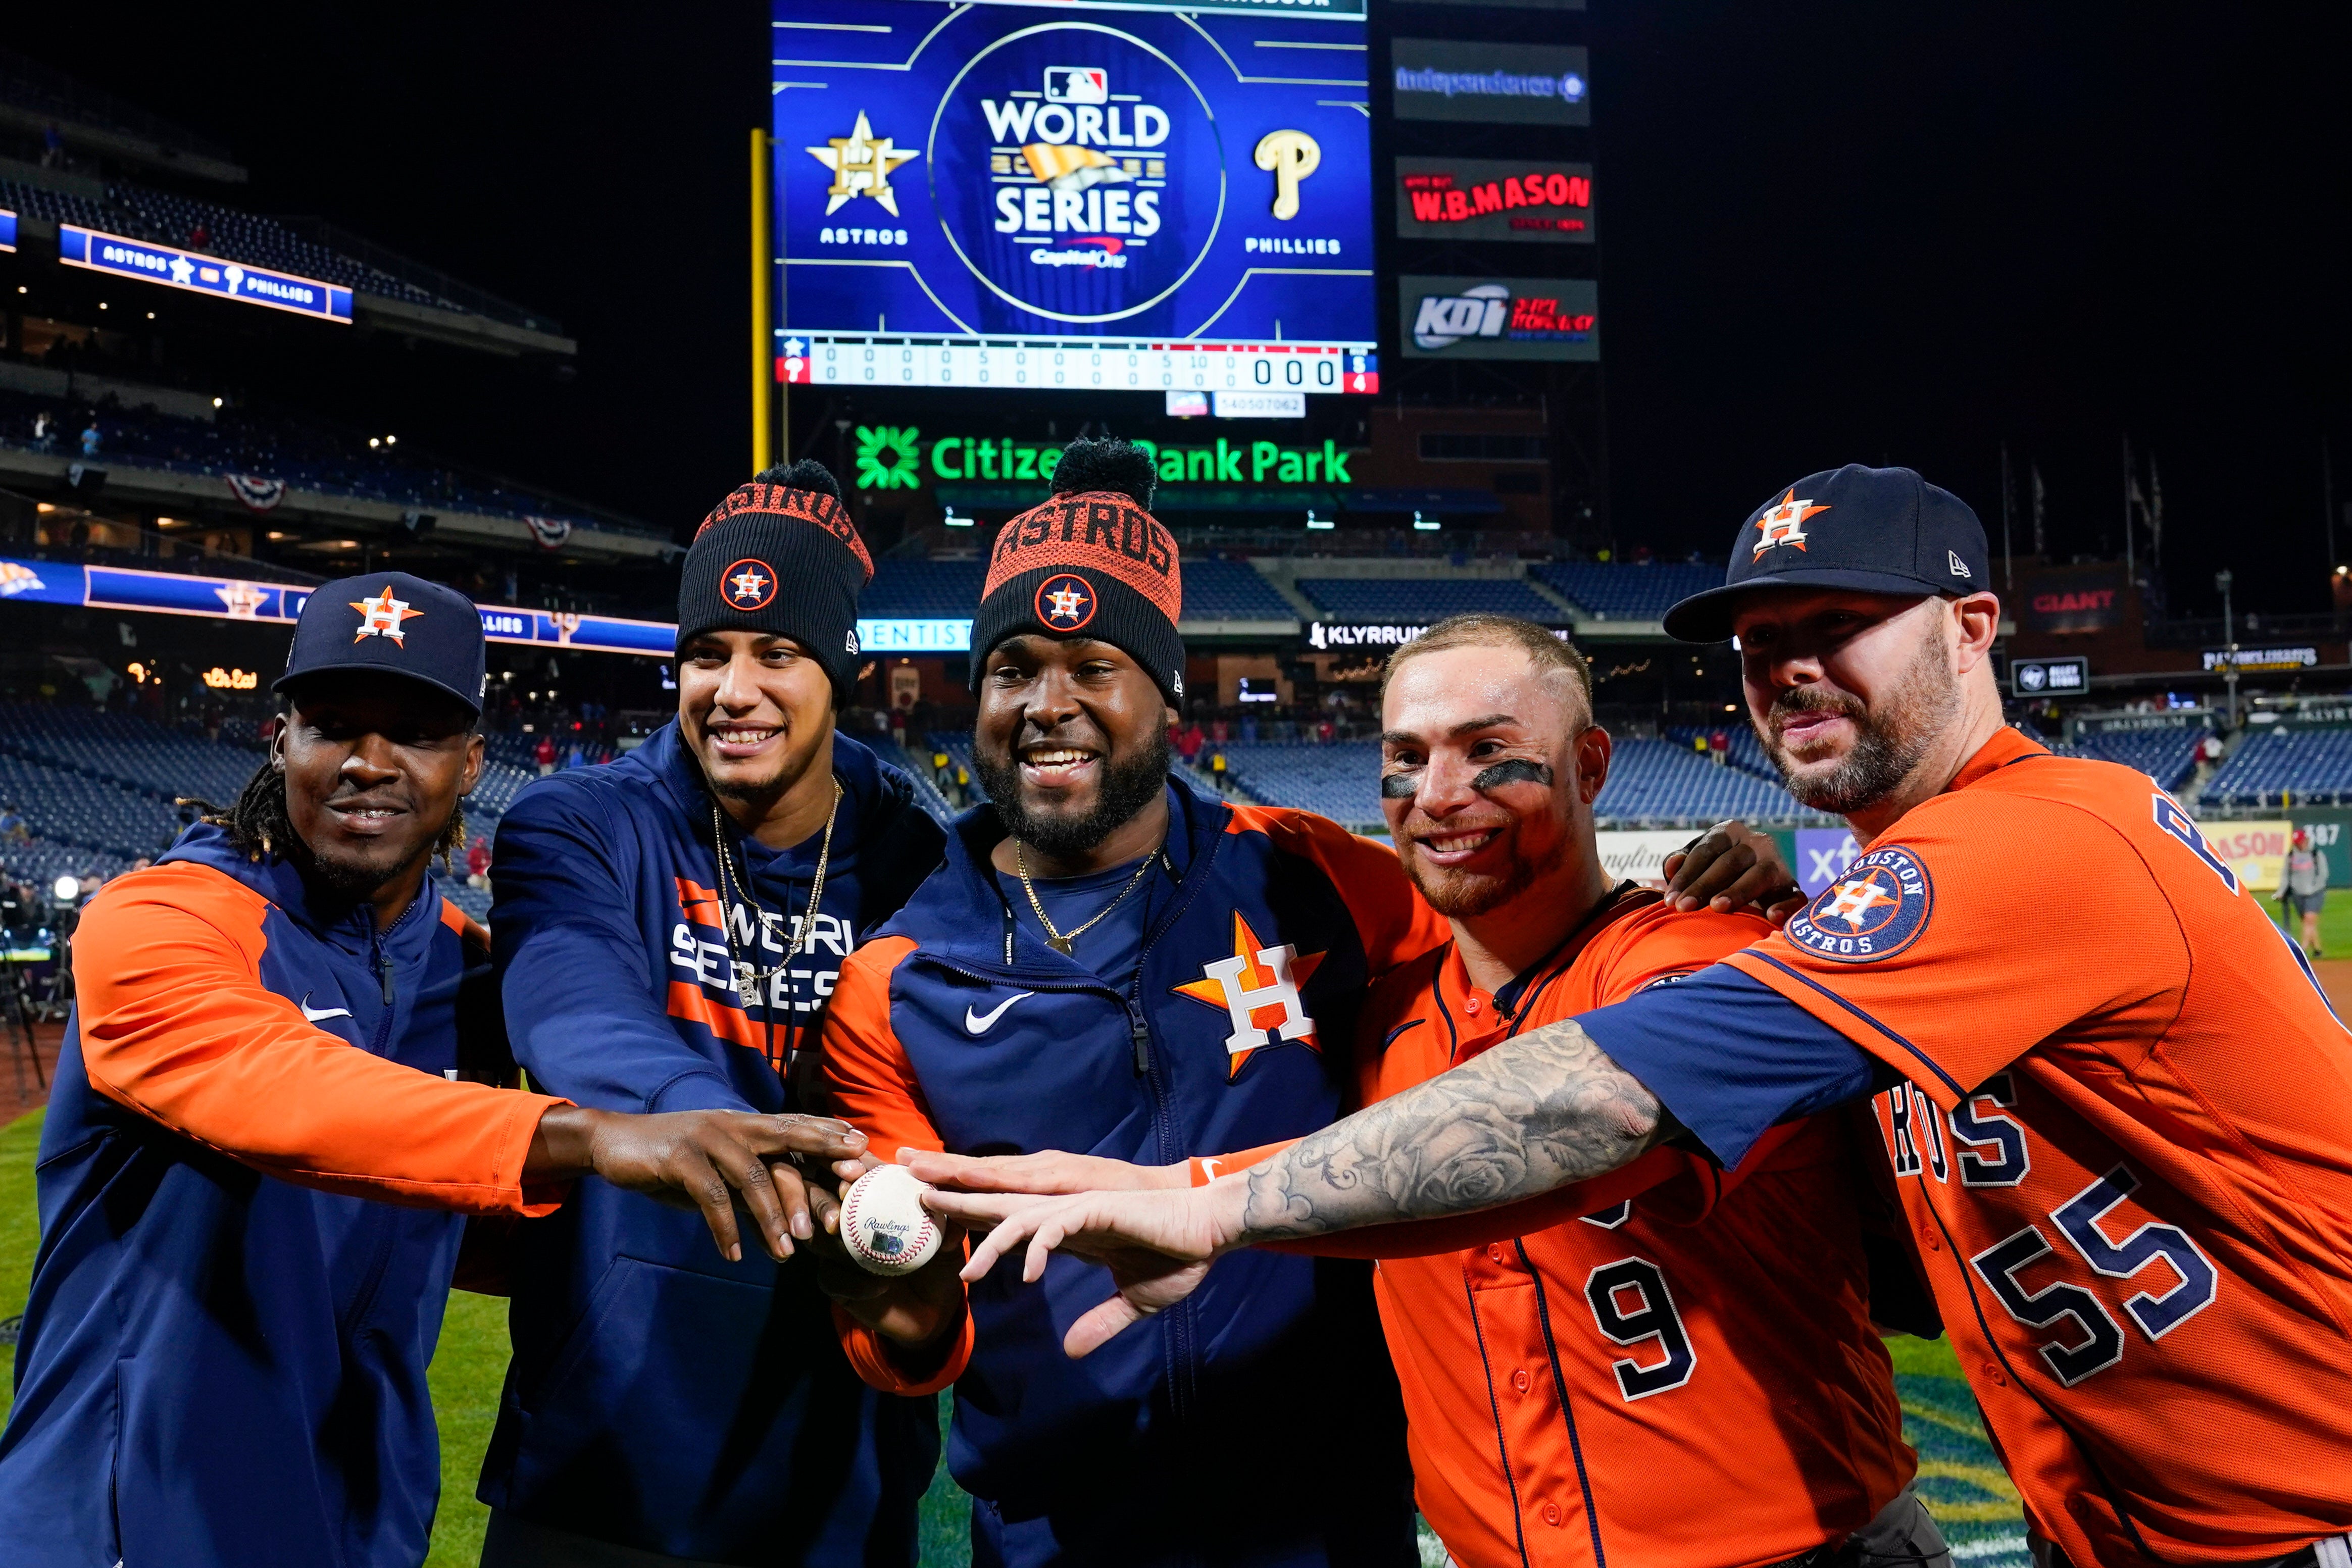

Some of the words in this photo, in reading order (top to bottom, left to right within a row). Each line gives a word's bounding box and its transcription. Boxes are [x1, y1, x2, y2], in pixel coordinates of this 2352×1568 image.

[981, 99, 1170, 147] WORLD
[995, 186, 1161, 237] SERIES
[820, 228, 908, 245] ASTROS
[1245, 237, 1341, 255] PHILLIES
[103, 245, 167, 272] ASTROS
[247, 277, 313, 304] PHILLIES
[1255, 360, 1270, 384] 0
[1287, 361, 1302, 385] 0
[1318, 361, 1333, 385] 0
[932, 438, 1064, 481] Citize
[1253, 438, 1353, 484] Park
[997, 501, 1171, 577] ASTROS
[1753, 499, 1814, 554] H
[735, 575, 763, 597] H
[1051, 591, 1081, 618] H
[2033, 590, 2115, 614] GIANT
[357, 597, 410, 639] H
[1819, 880, 1887, 926] H
[718, 900, 854, 956] WORL
[1792, 918, 1873, 953] ASTROS
[1203, 943, 1317, 1055] H
[864, 1217, 910, 1237] Rawlings
[1969, 1162, 2218, 1388] 55
[1583, 1255, 1697, 1402] 9
